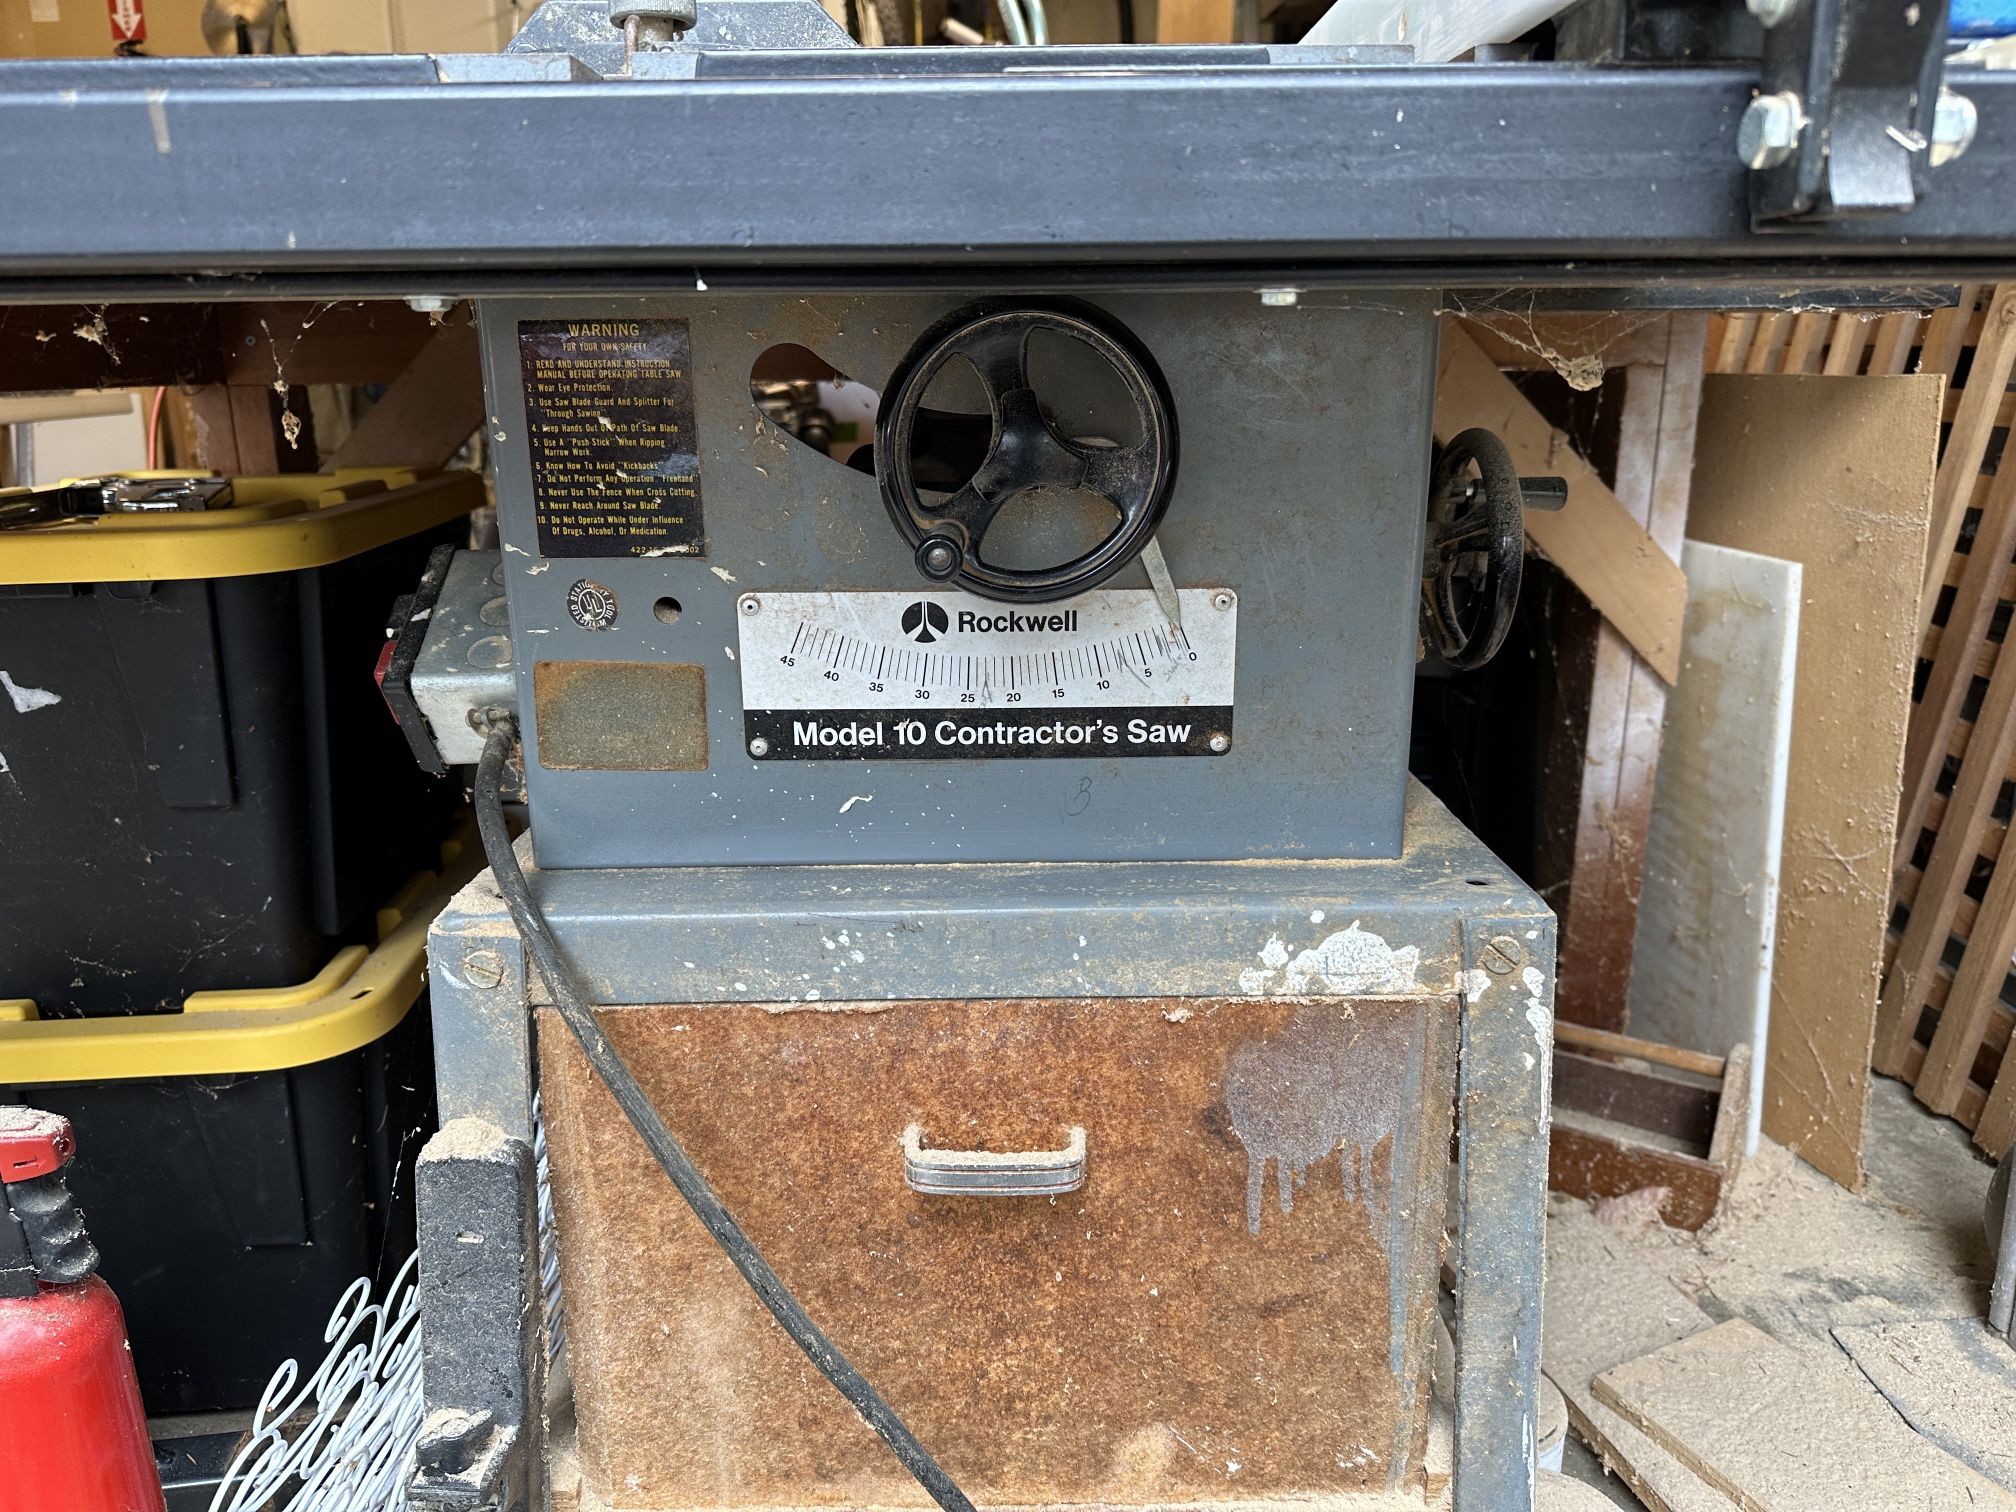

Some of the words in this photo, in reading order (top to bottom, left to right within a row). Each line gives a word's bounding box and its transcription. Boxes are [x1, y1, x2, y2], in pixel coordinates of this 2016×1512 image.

[568, 324, 640, 336] WARNING
[562, 342, 576, 351] FOR
[580, 342, 598, 351] YOUR
[600, 342, 618, 351] OWN
[526, 360, 534, 368] 1.
[536, 360, 554, 368] READ
[558, 360, 572, 368] AND
[574, 360, 621, 368] UNDERSTAND
[624, 360, 670, 368] INSTRUCTION
[536, 370, 566, 378] MANUAL
[568, 370, 596, 378] BEFORE
[598, 370, 638, 378] OPERATING
[641, 370, 663, 378] TABLE
[528, 384, 535, 392] 2.
[538, 384, 555, 392] Wear
[558, 384, 570, 394] Eye
[574, 384, 613, 392] Protection.
[528, 398, 536, 406] 3.
[539, 398, 552, 406] Use
[554, 398, 568, 406] Saw
[572, 398, 592, 406] Blade
[594, 398, 614, 406] Guard
[618, 398, 630, 406] And
[634, 398, 660, 408] Splitter
[664, 398, 674, 406] For
[532, 424, 540, 432] 4.
[562, 424, 582, 432] Hands
[586, 424, 598, 432] Out
[612, 424, 628, 432] Path
[630, 424, 639, 432] Of
[642, 424, 656, 432] Saw
[660, 424, 681, 432] Blade.
[534, 438, 540, 446] 5.
[544, 438, 556, 446] Use
[560, 438, 564, 446] A
[618, 438, 636, 446] When
[640, 438, 666, 448] Ripping
[544, 448, 568, 456] Narrow
[572, 448, 592, 456] Work.
[536, 462, 543, 470] 6.
[546, 462, 564, 470] Know
[566, 462, 580, 470] How
[584, 462, 593, 470] To
[596, 462, 615, 470] Avoid
[546, 474, 556, 482] Do
[559, 474, 572, 482] Not
[574, 474, 602, 482] Perform
[606, 474, 618, 484] Any
[538, 488, 546, 496] 8.
[548, 488, 568, 496] Never
[570, 488, 584, 496] Use
[586, 488, 599, 496] The
[602, 488, 622, 496] Fence
[625, 488, 644, 496] When
[647, 488, 666, 496] Cross
[670, 488, 698, 498] Cutting.
[540, 502, 547, 510] 9.
[550, 502, 570, 510] Never
[572, 502, 594, 510] Reach
[596, 502, 620, 510] Around
[622, 502, 636, 510] Saw
[640, 502, 662, 510] Blade.
[538, 516, 548, 524] 10.
[552, 516, 560, 524] Do
[563, 516, 576, 524] Not
[578, 516, 604, 526] Operate
[607, 516, 626, 524] While
[628, 516, 649, 524] Under
[652, 516, 684, 524] Influence
[552, 526, 560, 535] Of
[562, 526, 586, 536] Drugs,
[618, 526, 627, 535] Or
[630, 526, 669, 535] Medication.
[958, 610, 1078, 632] Rockwell
[780, 655, 795, 667] 45
[824, 670, 840, 682] 40
[868, 682, 884, 692] 35
[914, 690, 930, 700] 30
[960, 693, 975, 702] 25
[1006, 692, 1022, 702] 20
[1052, 688, 1065, 698] 15
[1096, 680, 1110, 690] 10
[1144, 668, 1152, 678] 5
[1188, 652, 1197, 662] 0
[793, 721, 883, 746] Model
[893, 720, 926, 746] 10
[934, 719, 1119, 745] Contractor's
[1127, 718, 1192, 744] Saw
